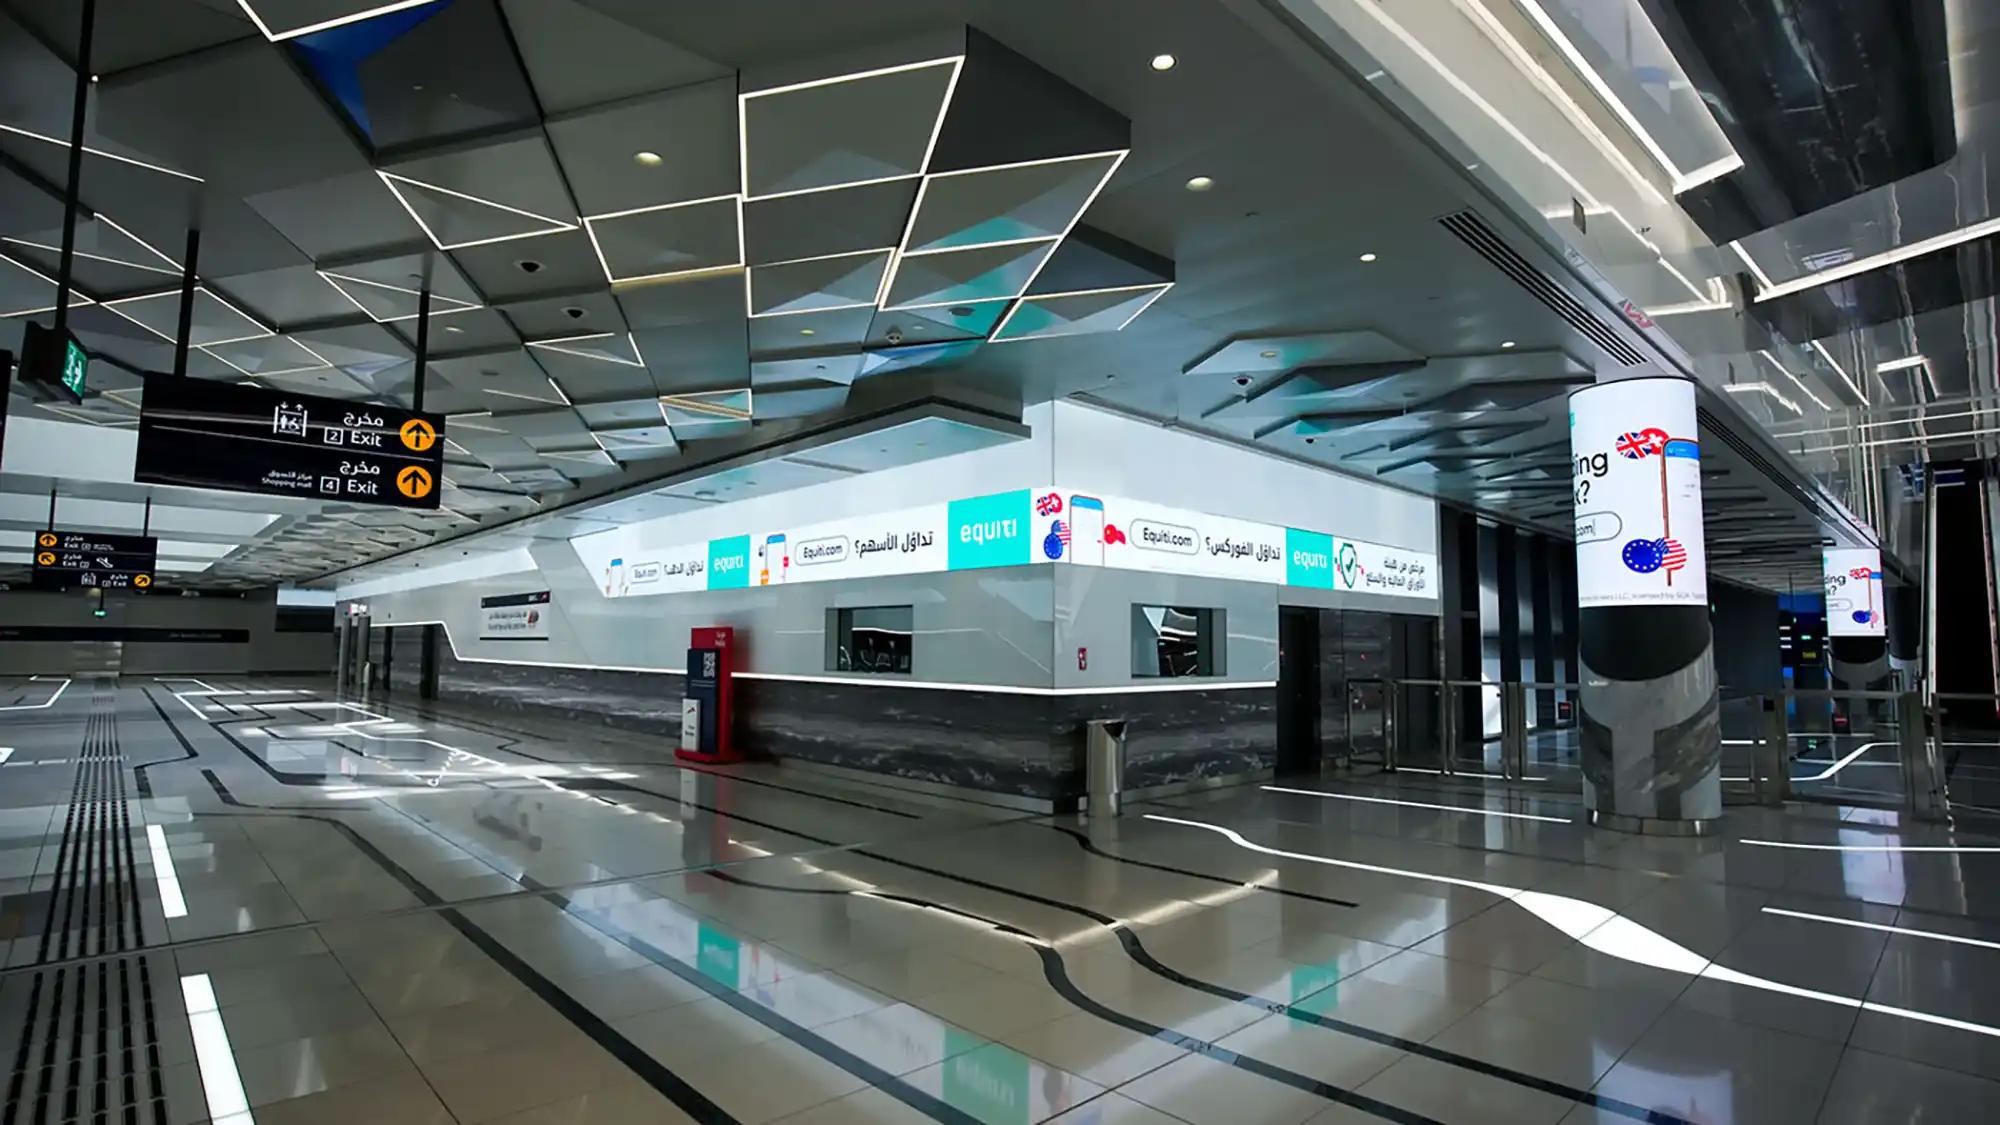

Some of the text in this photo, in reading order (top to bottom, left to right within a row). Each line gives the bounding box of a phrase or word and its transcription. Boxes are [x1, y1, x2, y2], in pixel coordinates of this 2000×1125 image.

[343, 411, 384, 427] مخرج
[329, 430, 383, 447] 2 Exit
[340, 461, 380, 476] مخرج
[262, 477, 296, 488] Shopping
[325, 479, 378, 495] 4 Exit
[960, 518, 1017, 546] equiti
[1143, 527, 1193, 546] Equiti.com
[803, 545, 843, 559] Equiti.com
[854, 531, 898, 559] الأسهم؟
[1293, 550, 1328, 570] equiti
